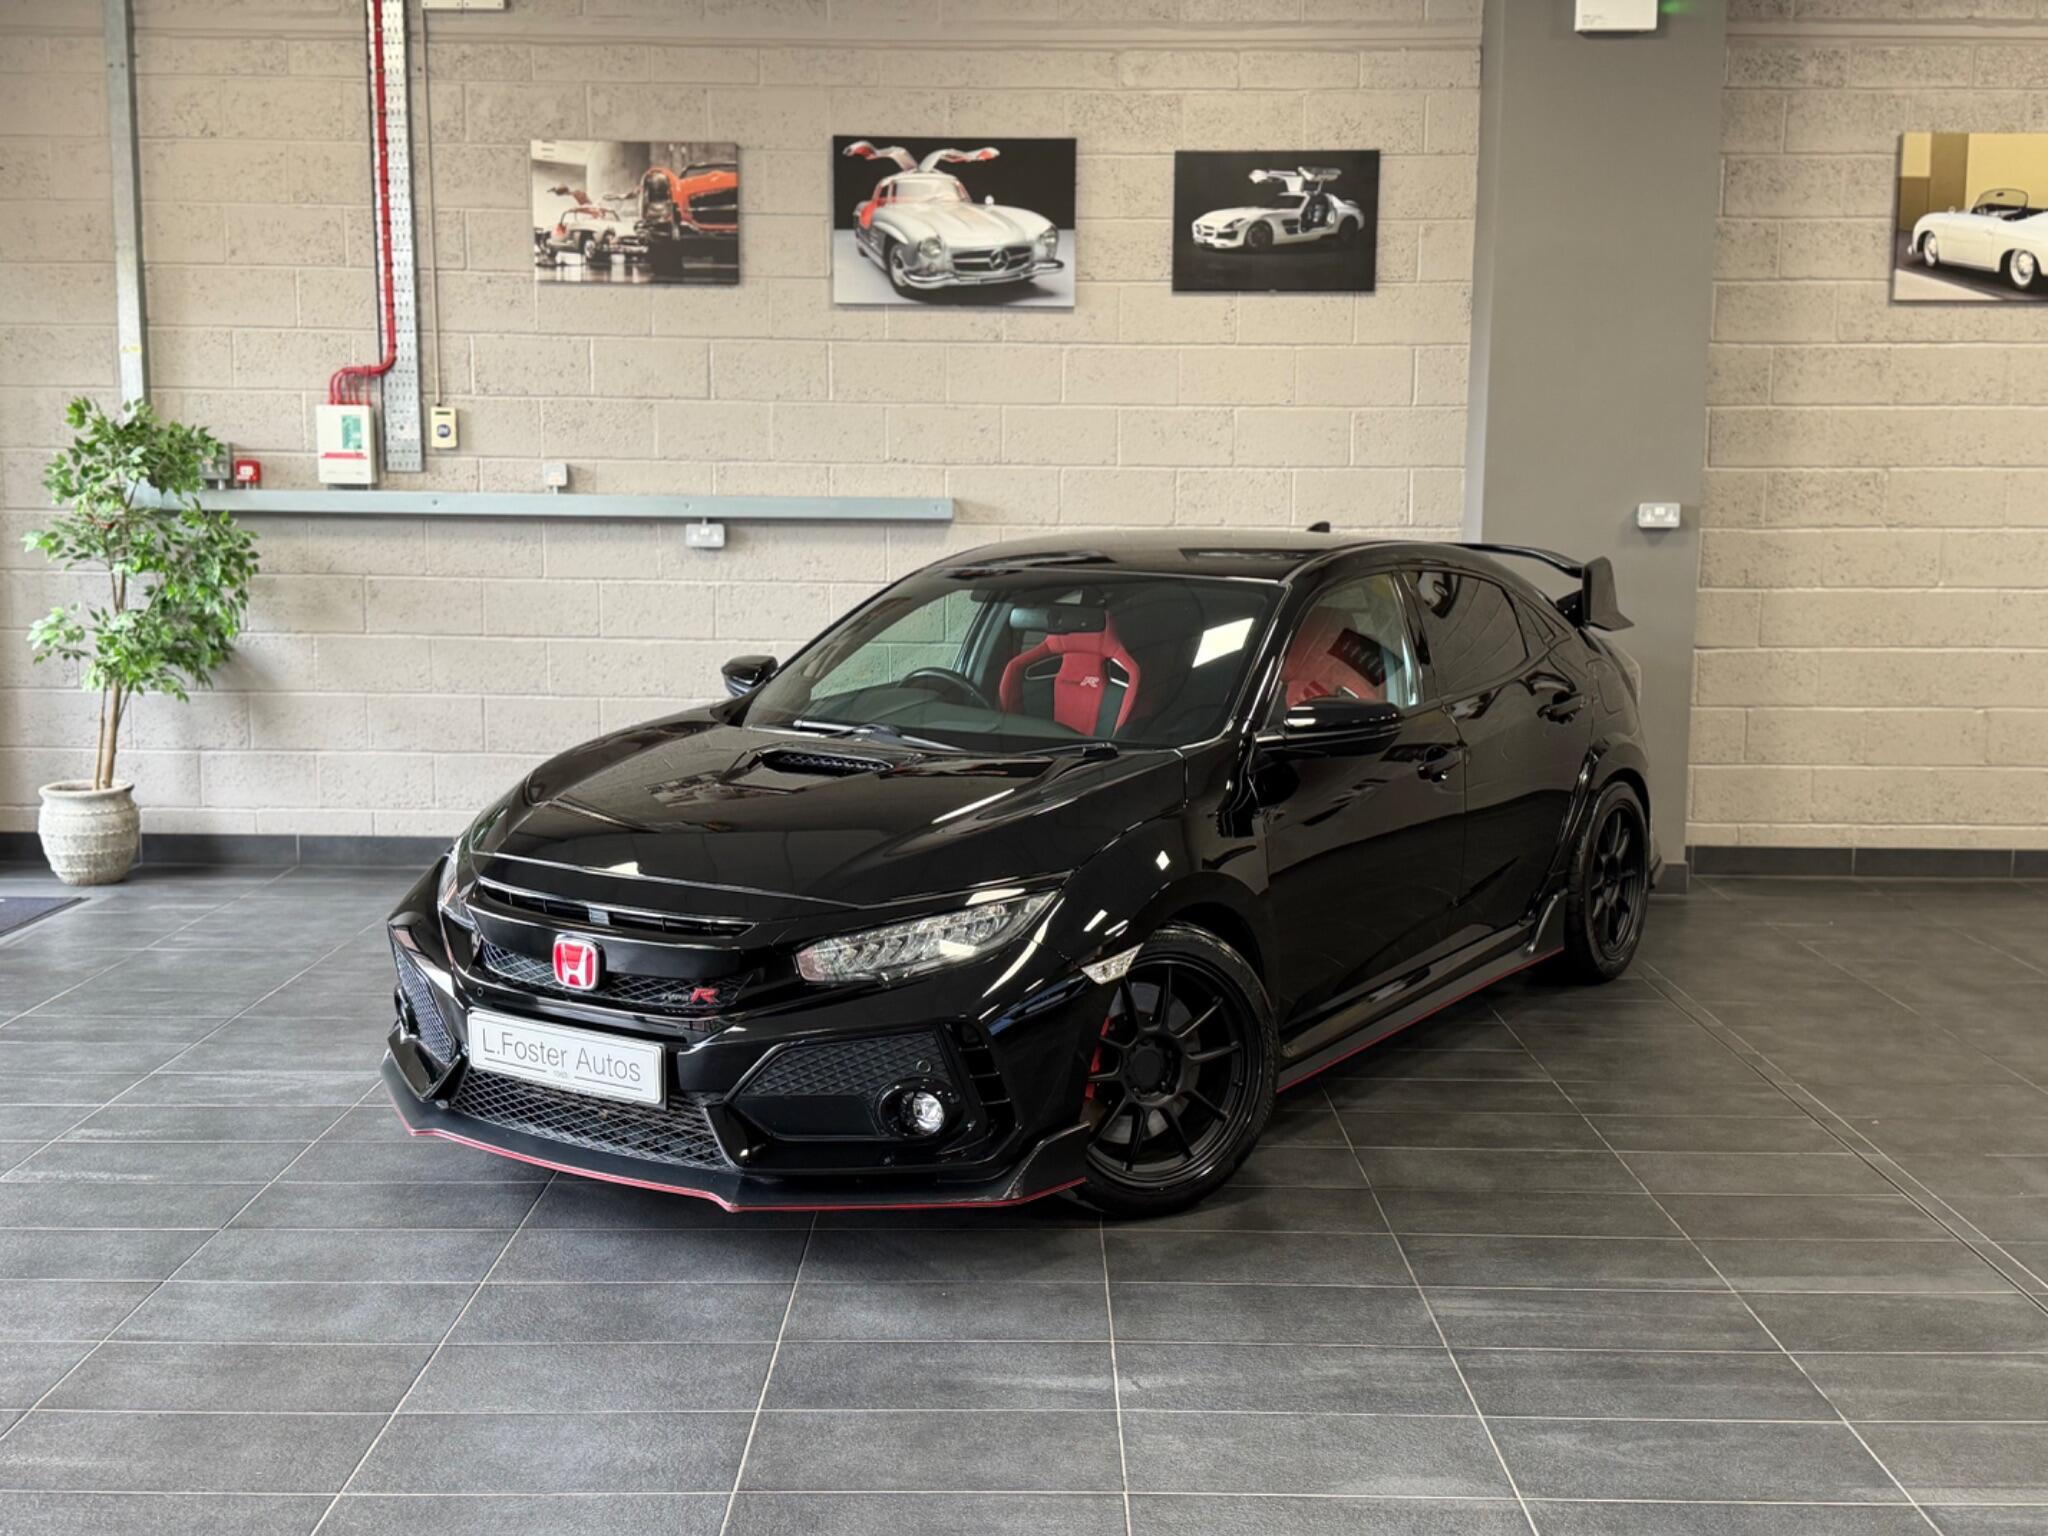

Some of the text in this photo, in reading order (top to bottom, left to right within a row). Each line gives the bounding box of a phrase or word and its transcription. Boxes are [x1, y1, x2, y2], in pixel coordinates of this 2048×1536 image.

[690, 987, 719, 1005] R
[482, 1028, 641, 1082] L.Foster Autos
